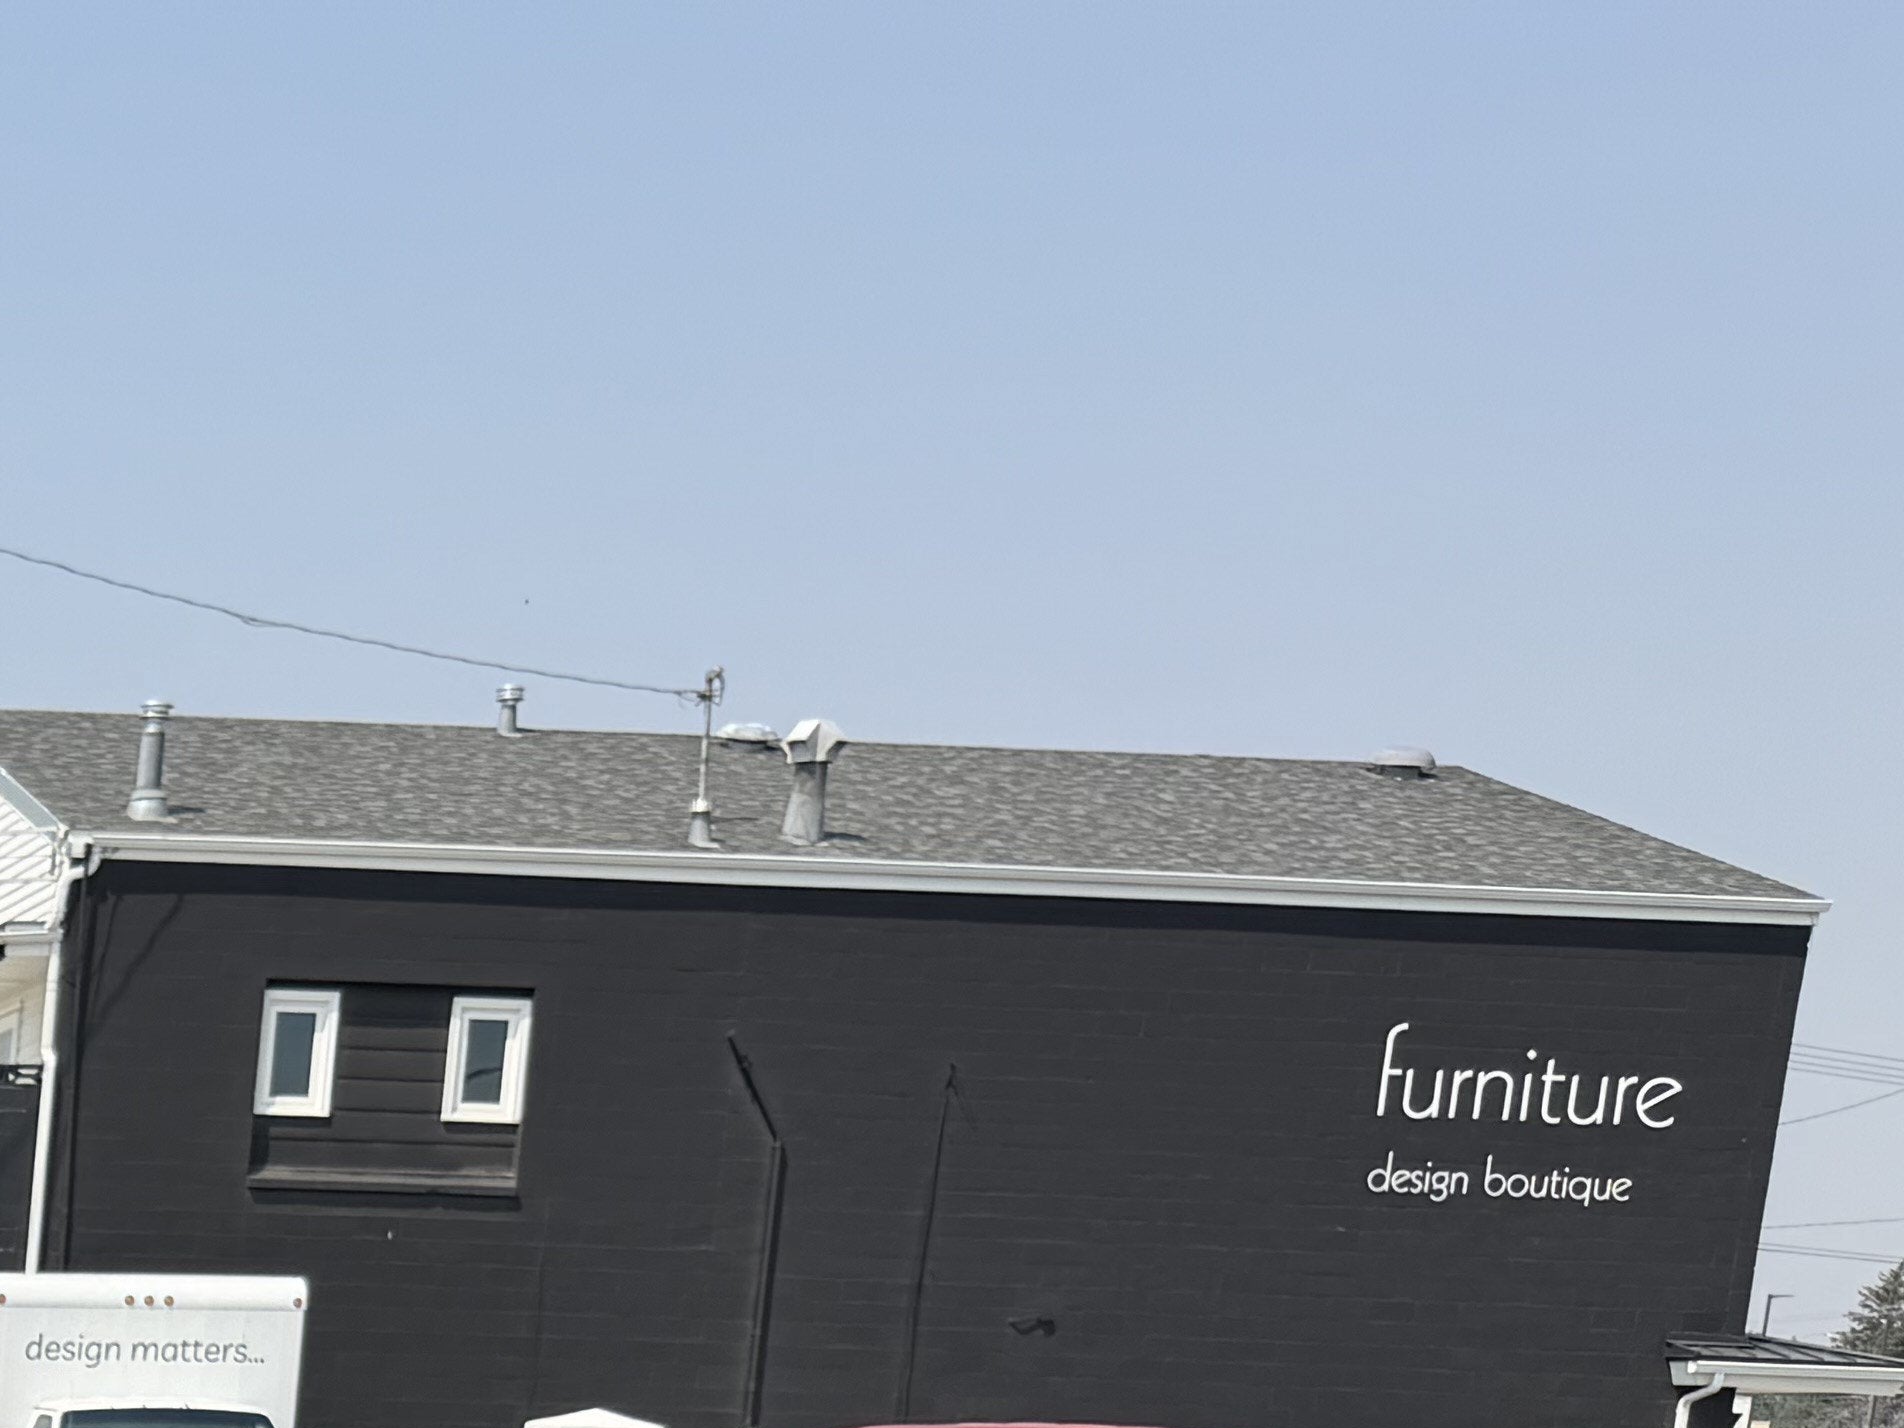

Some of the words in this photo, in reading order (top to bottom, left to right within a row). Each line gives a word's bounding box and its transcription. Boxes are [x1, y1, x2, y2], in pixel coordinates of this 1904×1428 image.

[1376, 1022, 1683, 1129] furniture
[1366, 1150, 1469, 1202] design
[1484, 1154, 1633, 1207] boutique
[24, 1332, 122, 1368] design
[130, 1340, 265, 1364] matters...
